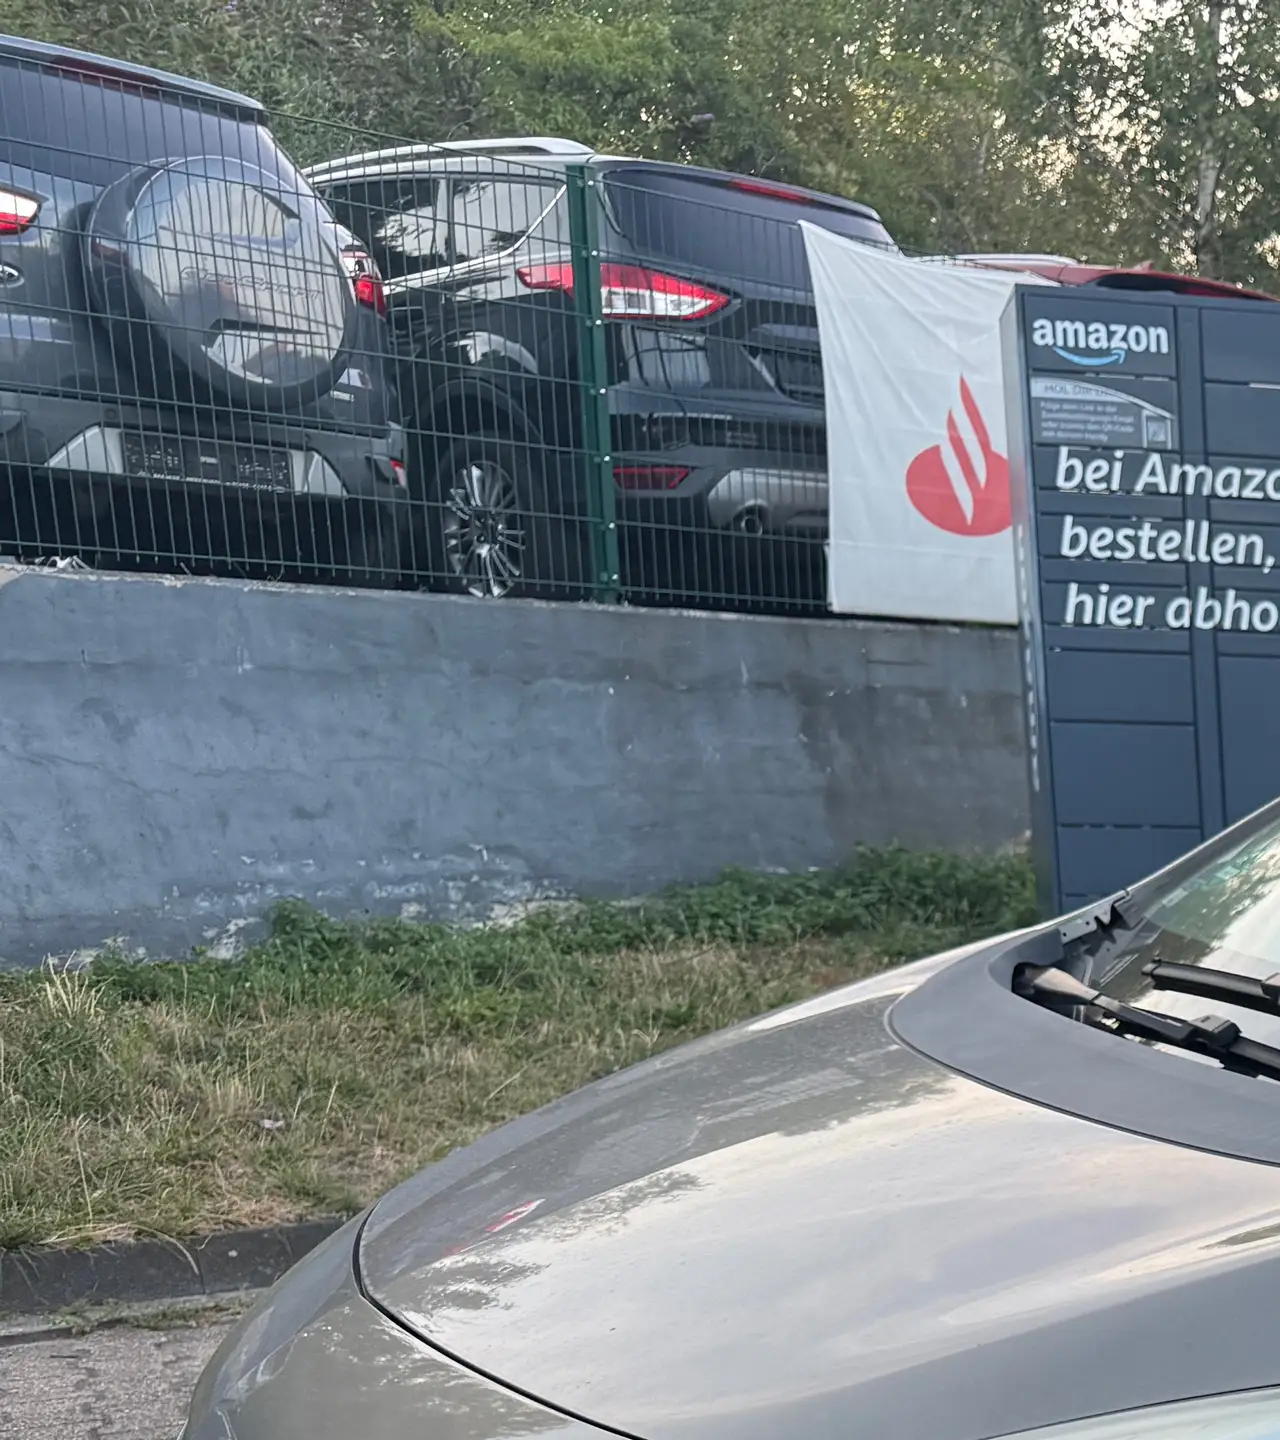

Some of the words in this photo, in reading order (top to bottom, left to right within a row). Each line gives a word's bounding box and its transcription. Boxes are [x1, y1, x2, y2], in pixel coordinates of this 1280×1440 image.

[1032, 318, 1169, 354] amazon
[1056, 445, 1124, 491] bei
[1060, 515, 1276, 574] bestellen,
[1065, 582, 1155, 627] hier
